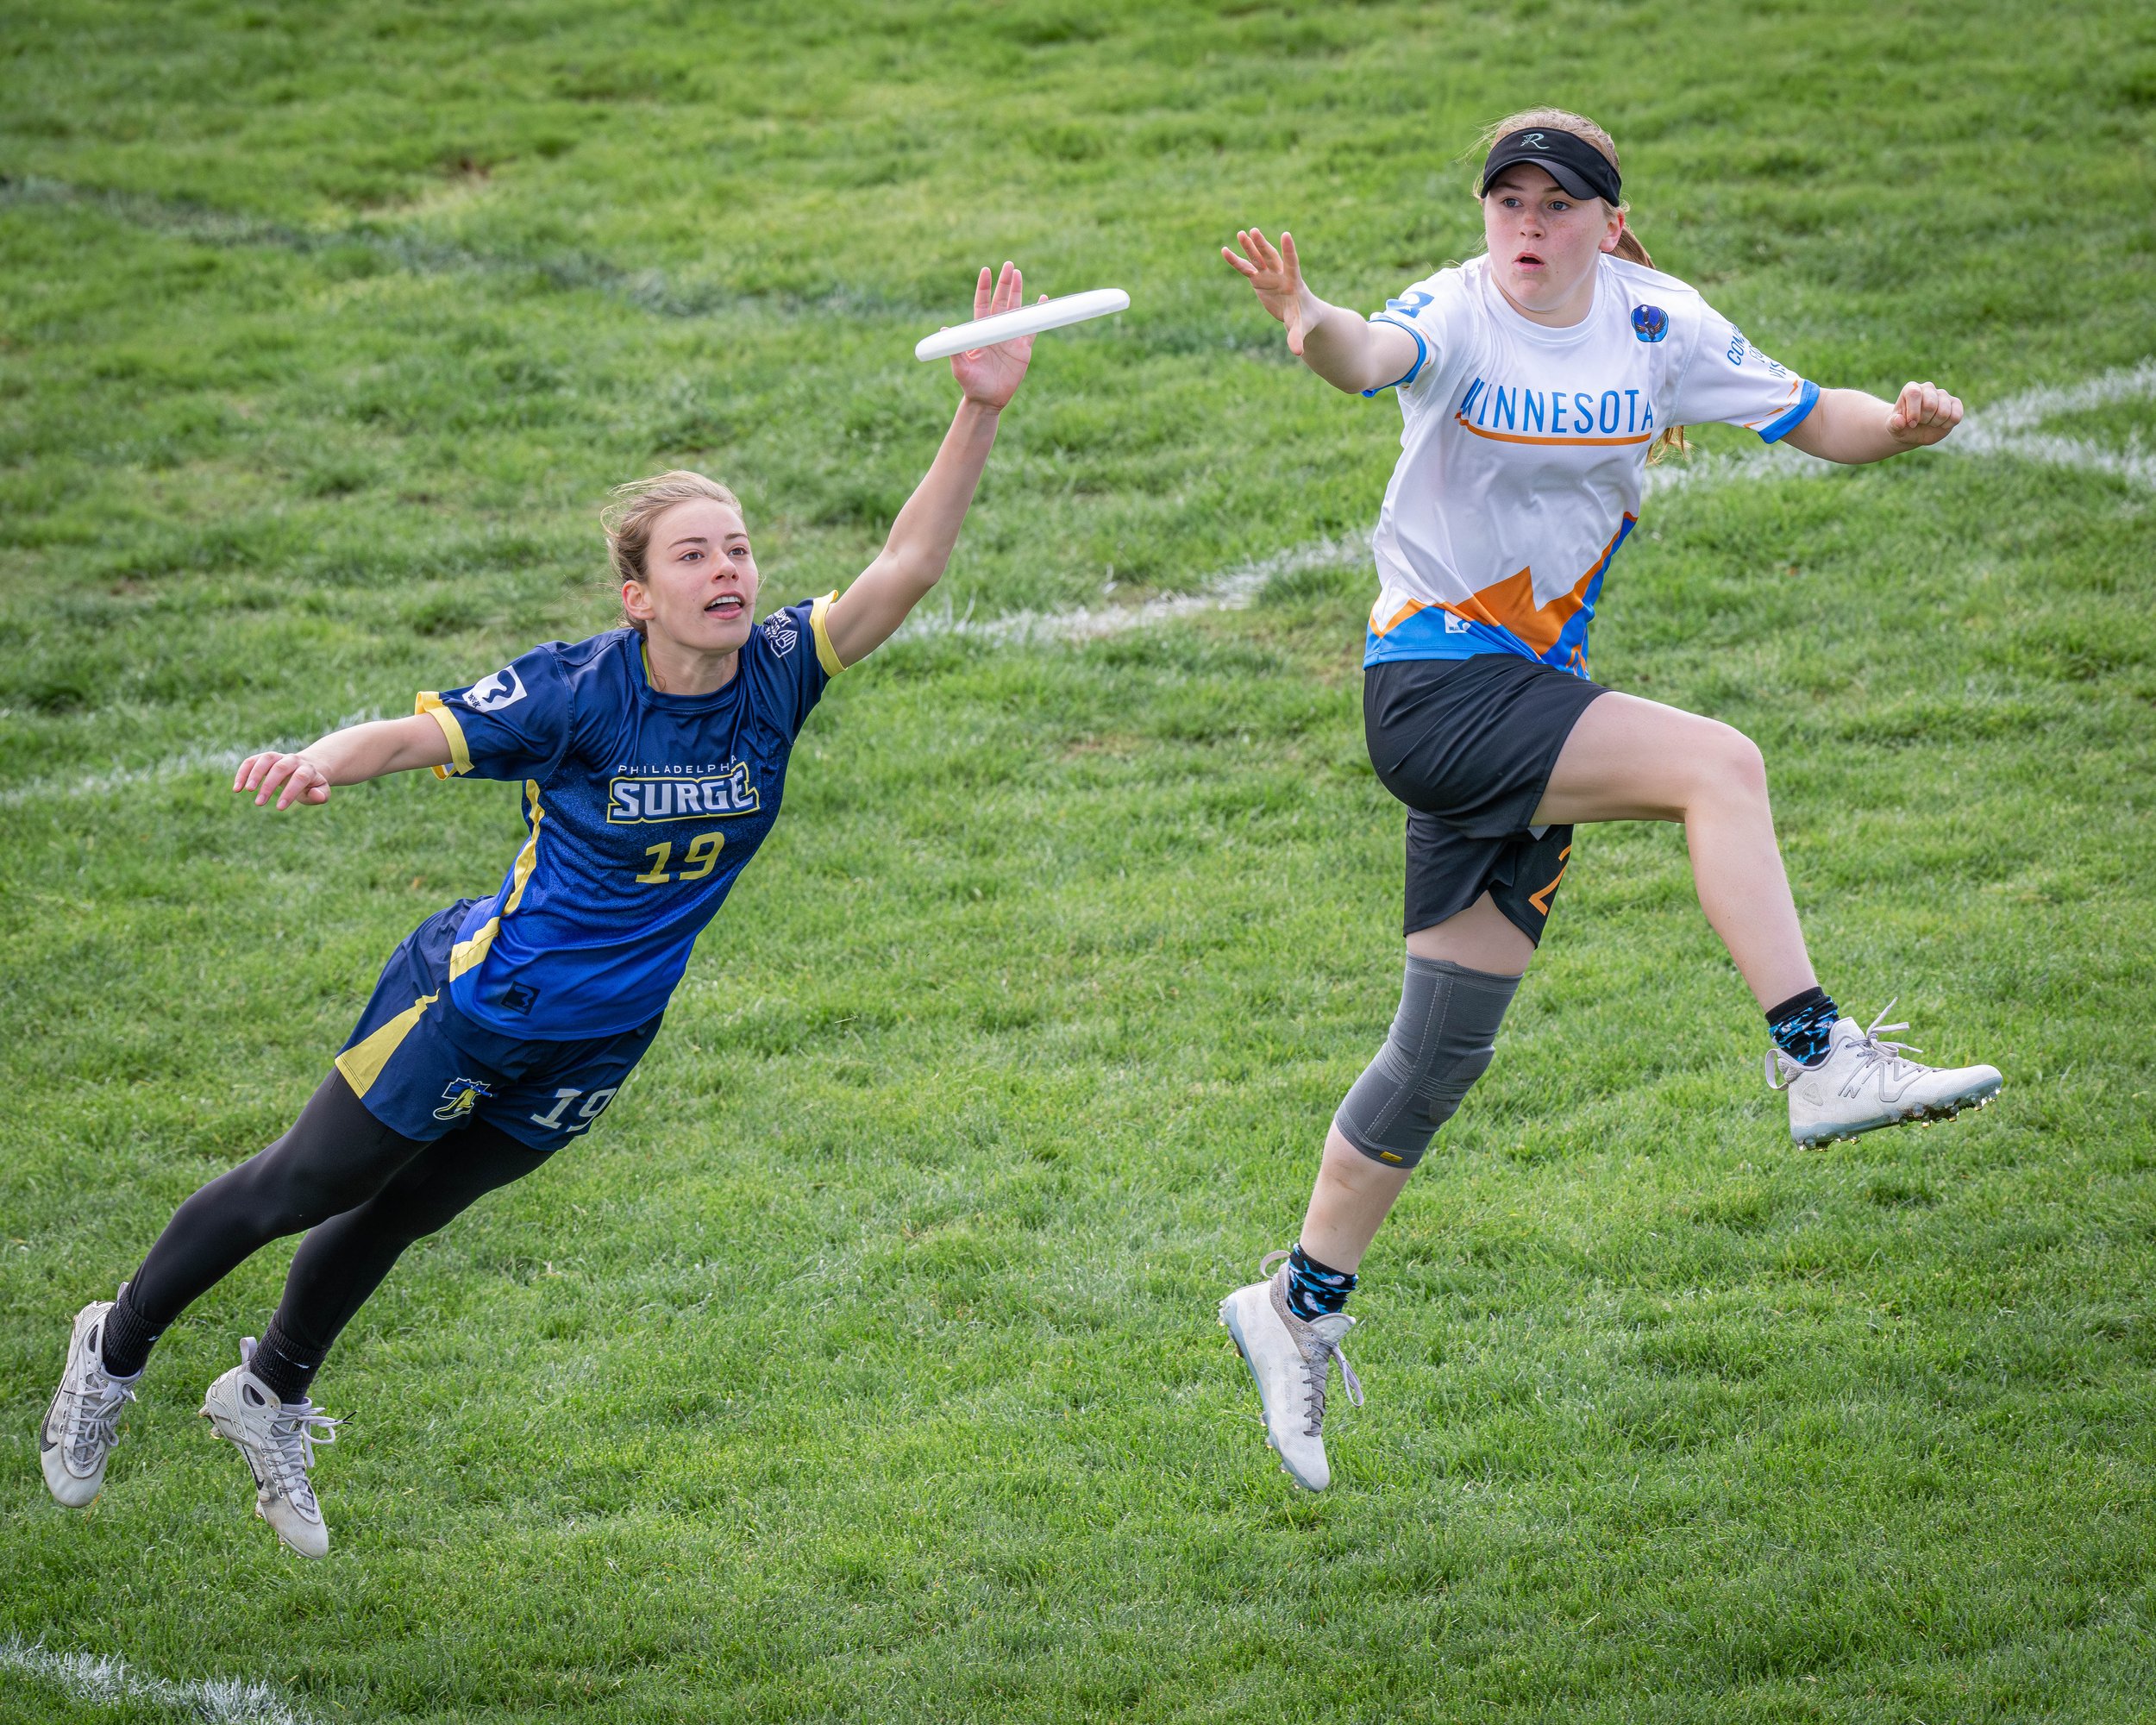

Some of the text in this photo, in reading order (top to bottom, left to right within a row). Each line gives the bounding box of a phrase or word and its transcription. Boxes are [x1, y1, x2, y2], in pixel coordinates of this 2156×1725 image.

[617, 755, 738, 775] PHILADELPHA
[612, 769, 754, 818] SURGE
[635, 831, 725, 884] 19
[530, 1088, 617, 1132] 19
